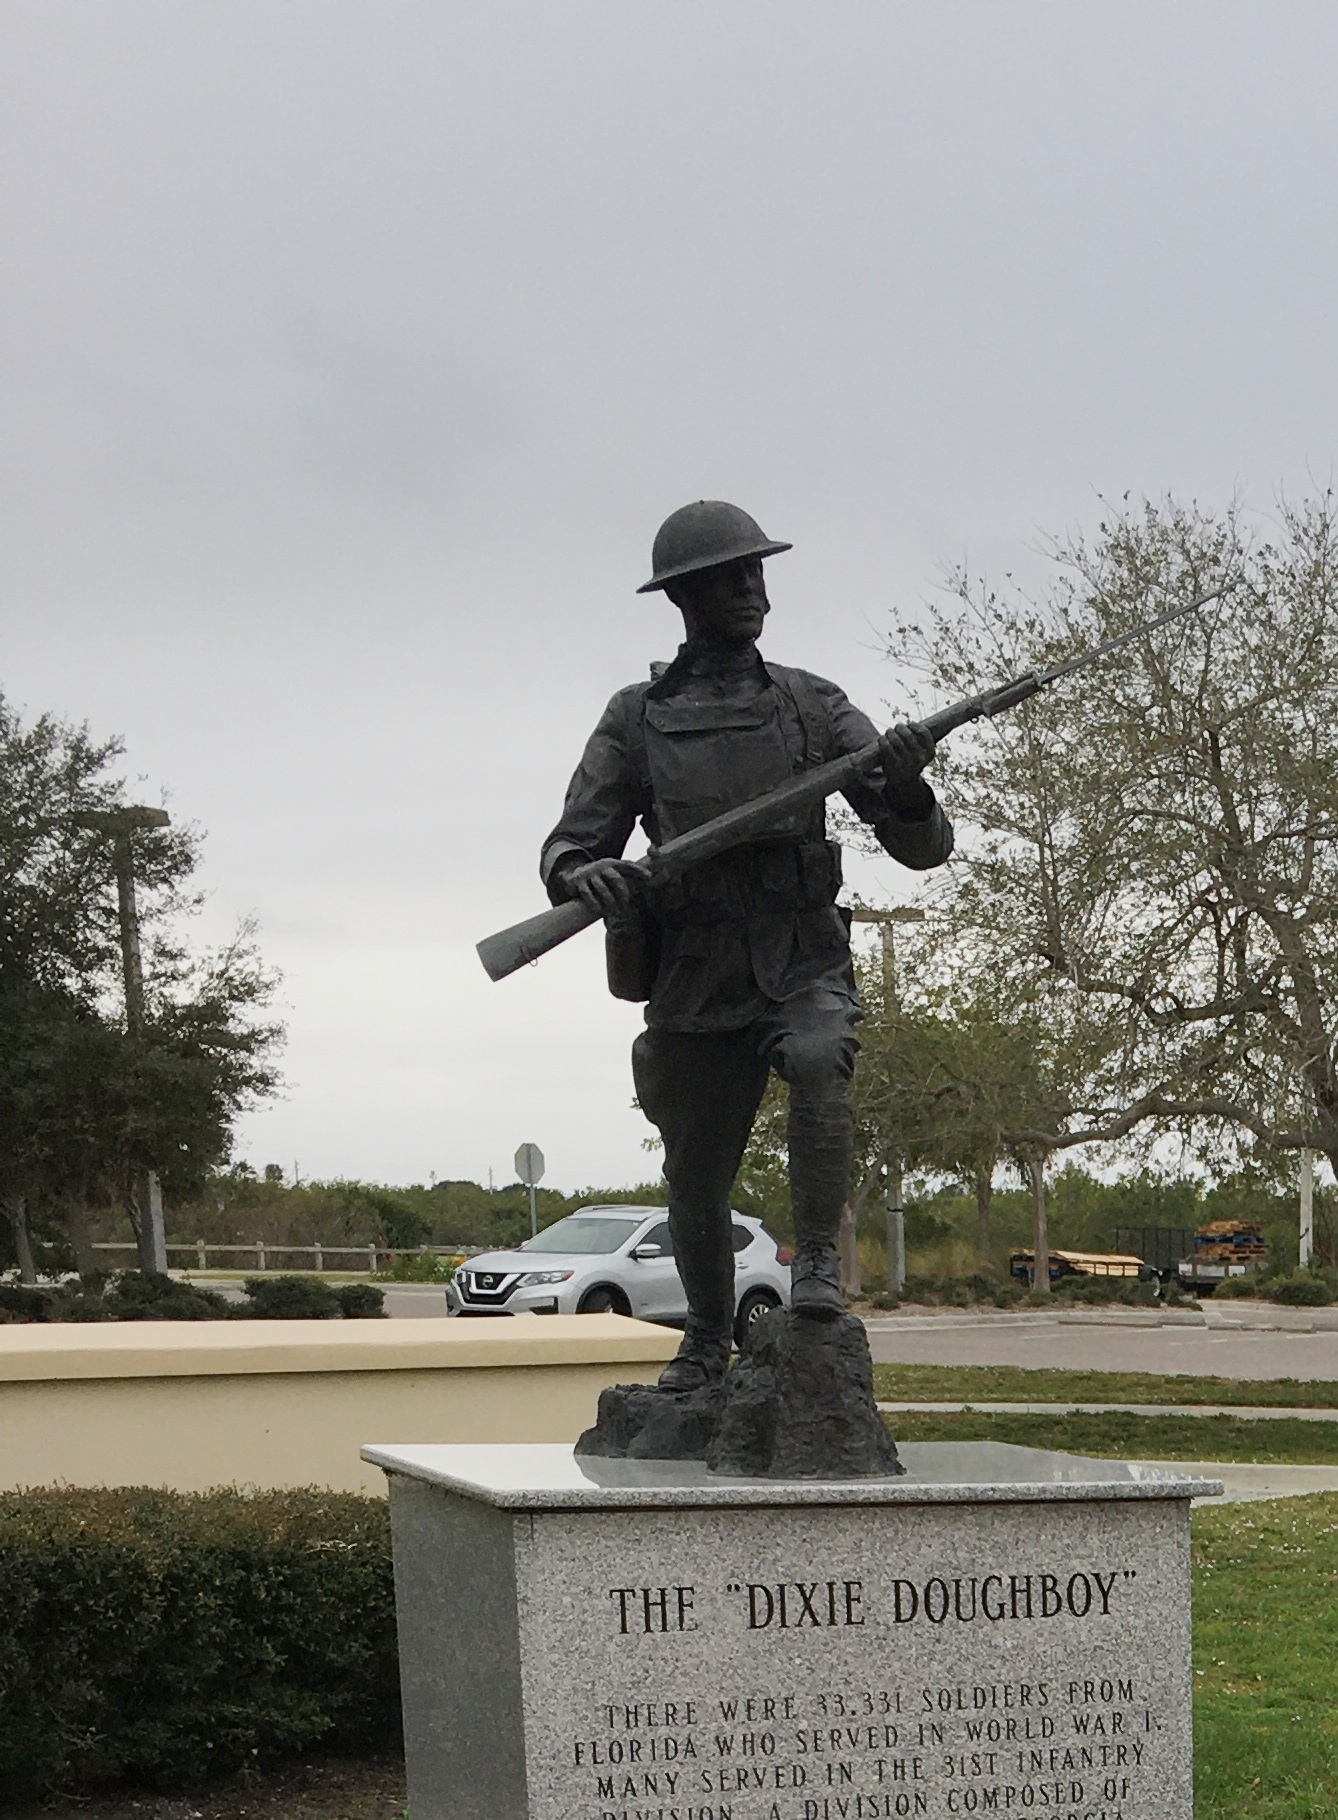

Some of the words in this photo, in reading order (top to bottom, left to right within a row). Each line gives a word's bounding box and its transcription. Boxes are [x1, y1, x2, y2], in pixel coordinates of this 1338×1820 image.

[608, 1583, 698, 1635] THE
[892, 1570, 1137, 1625] DOUGHBOY"
[606, 1701, 698, 1730] THERE
[720, 1696, 796, 1724] WERE
[921, 1684, 1049, 1714] SOLDIERS
[1068, 1680, 1134, 1707] FROM
[573, 1734, 698, 1767] FLORIDA
[715, 1730, 776, 1759] WHO
[795, 1723, 899, 1754] SERVED
[918, 1721, 945, 1747] IN
[966, 1715, 1054, 1744] WORLD
[1072, 1711, 1126, 1738] WAR
[596, 1770, 678, 1800] MANY
[700, 1763, 807, 1793] SERVED
[826, 1760, 853, 1786] IN
[874, 1756, 924, 1783] THE
[942, 1752, 999, 1778] 31ST
[1017, 1743, 1144, 1774] INFANTRY
[804, 1789, 928, 1820] DIVISION
[947, 1780, 1083, 1812] COMPOSED
[1104, 1777, 1132, 1801] OF
